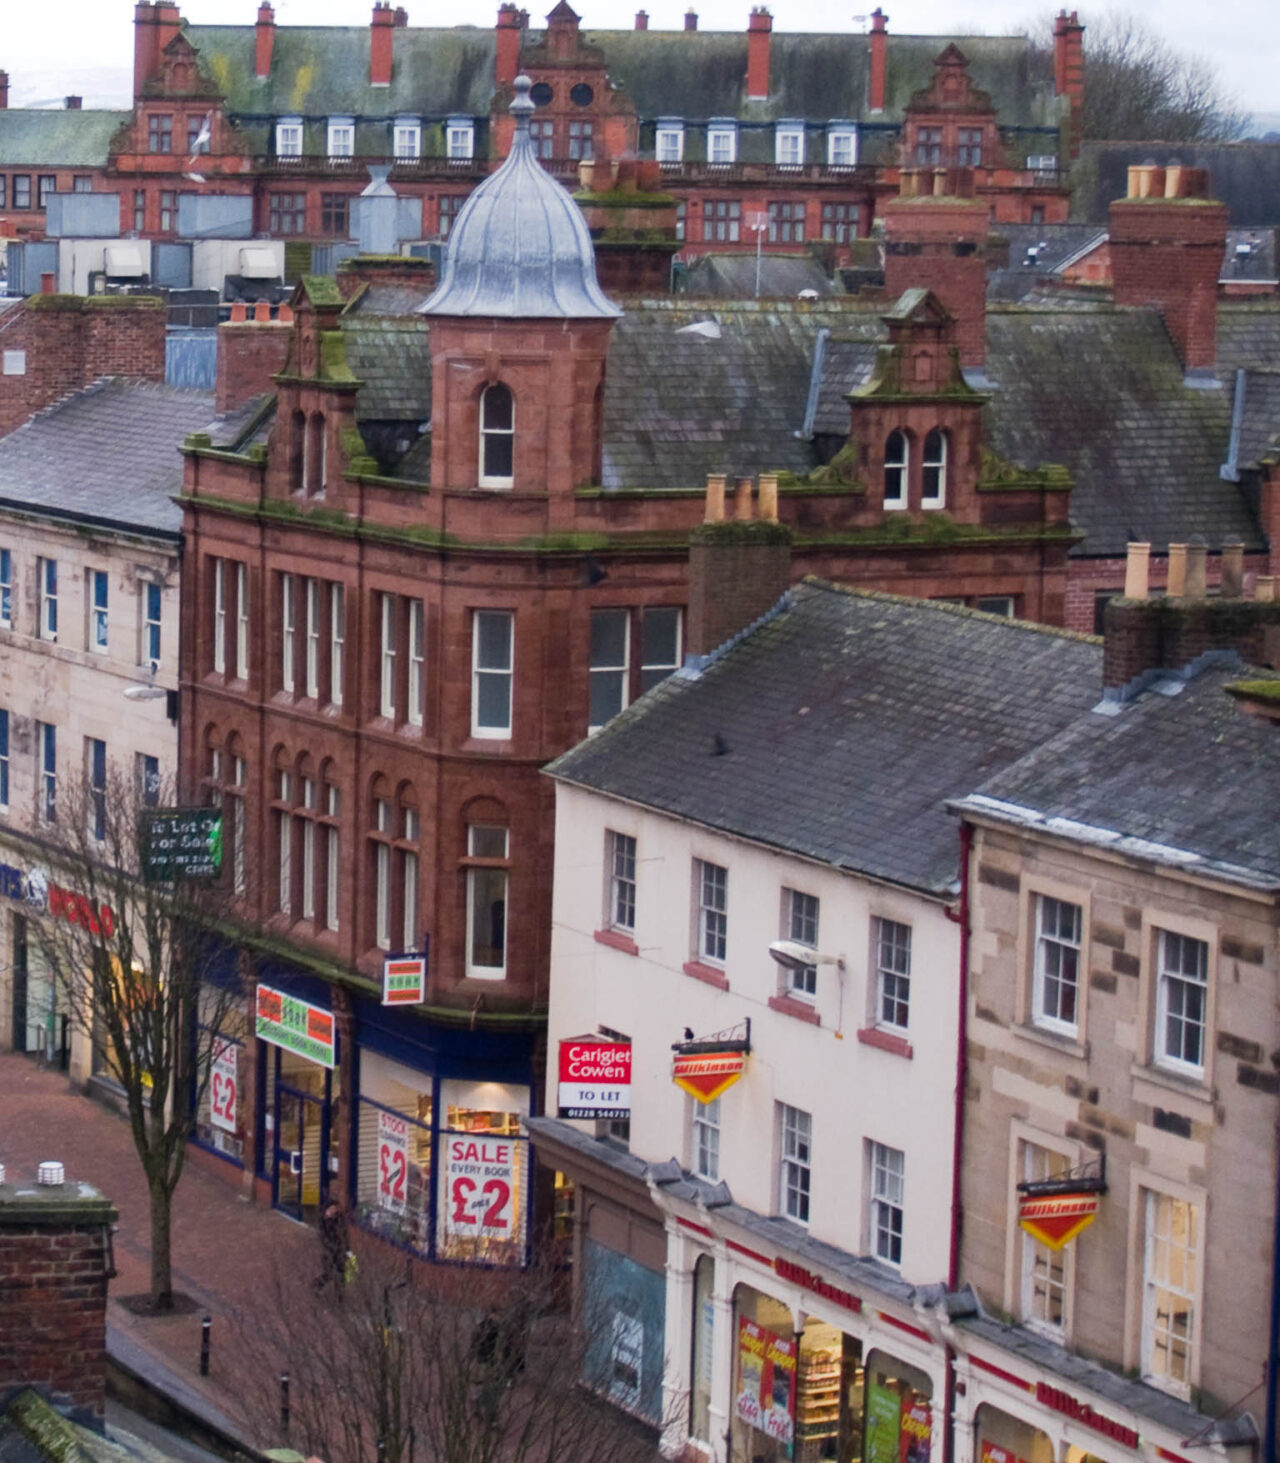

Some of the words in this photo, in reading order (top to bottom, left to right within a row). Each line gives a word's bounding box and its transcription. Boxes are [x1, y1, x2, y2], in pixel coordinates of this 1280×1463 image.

[568, 1046, 631, 1066] Carigiet
[568, 1062, 625, 1078] Cowen
[213, 1071, 236, 1123] £2
[579, 1090, 596, 1101] TO
[600, 1091, 620, 1101] LET
[452, 1141, 509, 1164] SALE
[381, 1144, 406, 1201] £2
[451, 1163, 482, 1175] EVERY
[484, 1165, 512, 1177] BOOK
[452, 1176, 510, 1228] £2
